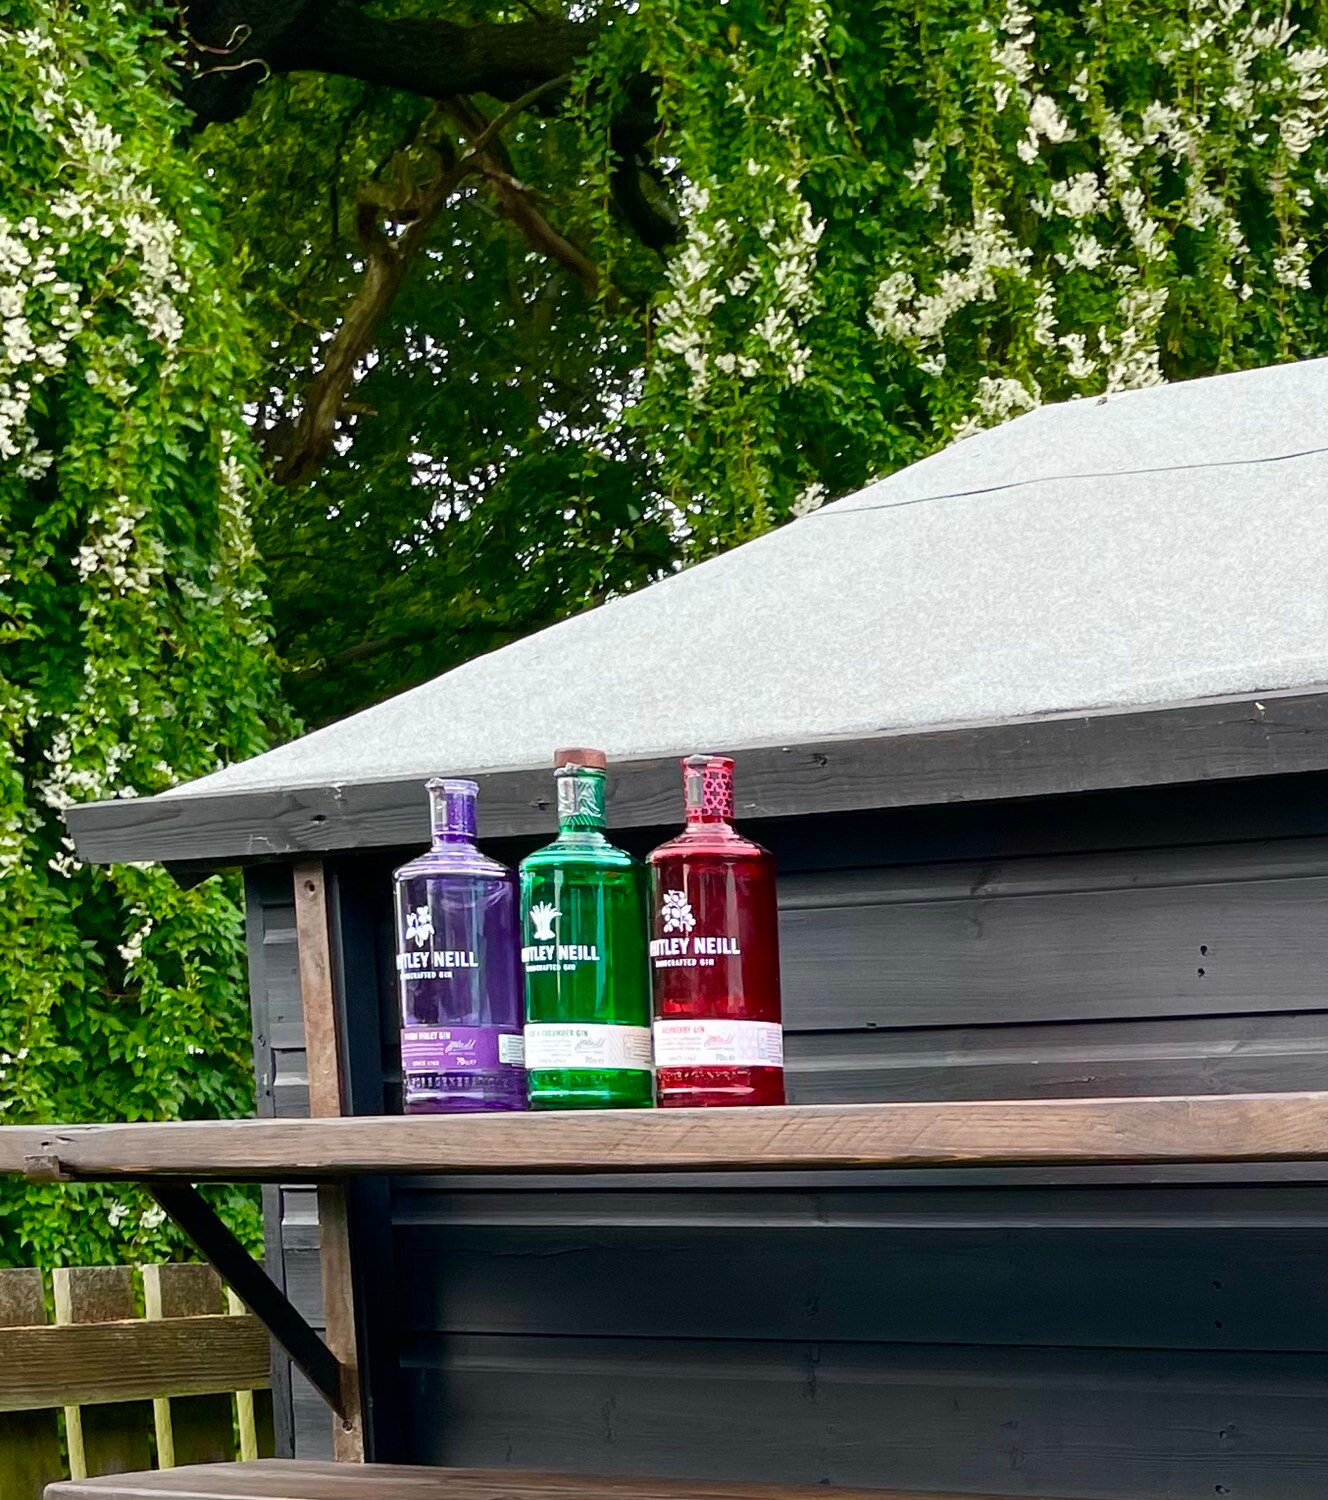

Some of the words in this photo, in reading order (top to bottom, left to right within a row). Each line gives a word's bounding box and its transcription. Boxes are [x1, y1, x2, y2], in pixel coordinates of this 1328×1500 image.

[558, 945, 600, 961] NEILL
[694, 937, 740, 955] NEILL
[434, 951, 479, 968] NEILL
